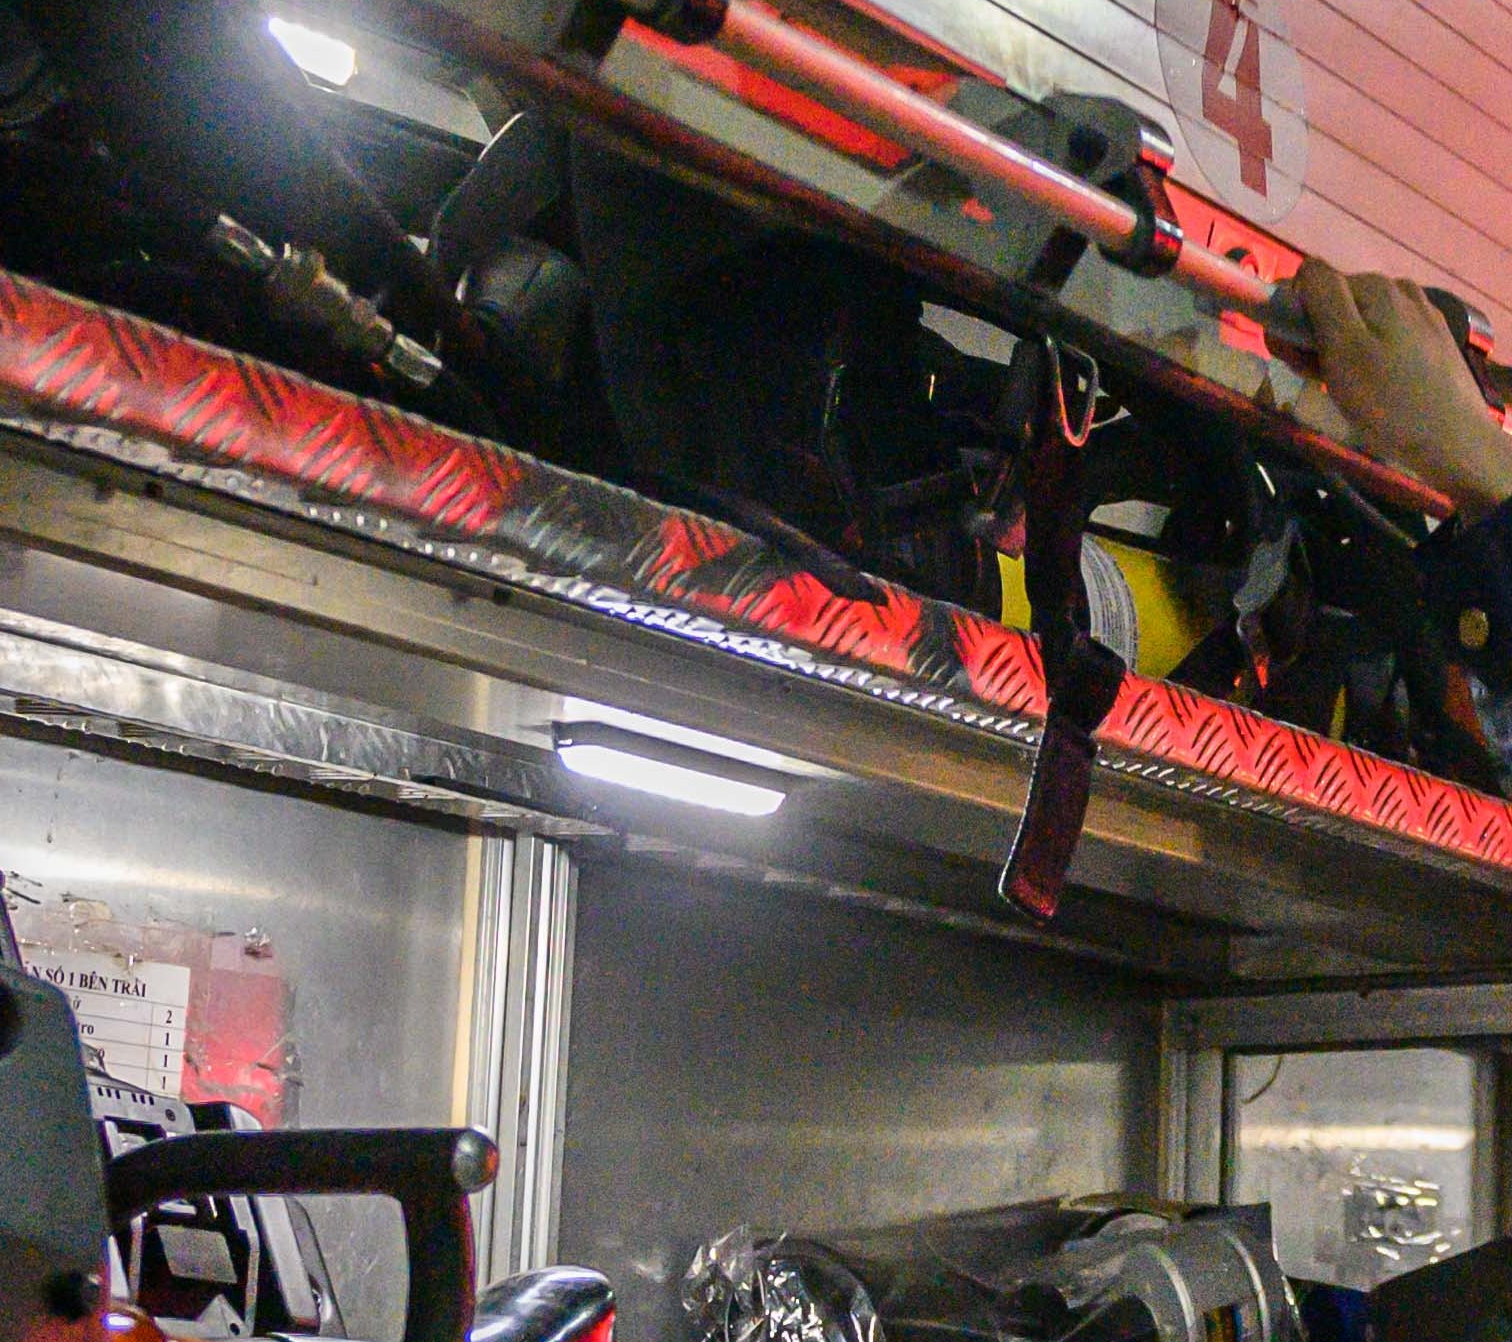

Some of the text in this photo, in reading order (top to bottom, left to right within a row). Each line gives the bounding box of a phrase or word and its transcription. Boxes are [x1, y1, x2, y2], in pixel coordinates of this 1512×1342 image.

[165, 1010, 173, 1024] 2
[164, 1032, 170, 1046] 1
[163, 1054, 168, 1068] 1
[161, 1076, 167, 1090] 1
